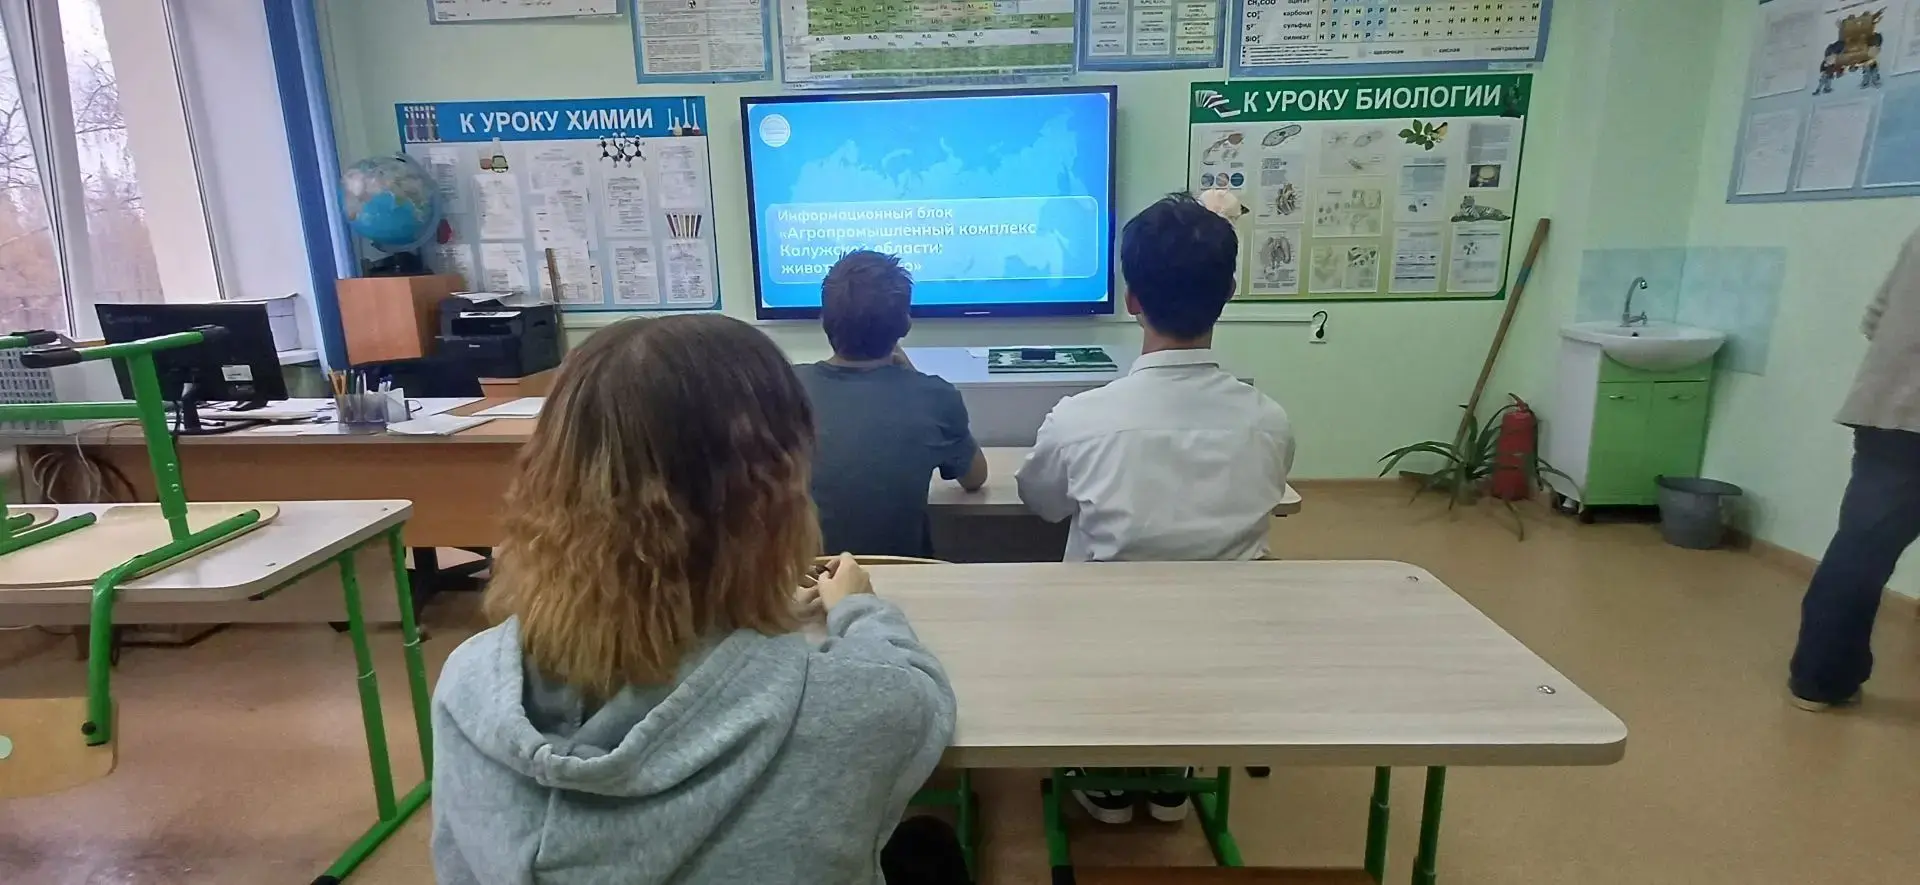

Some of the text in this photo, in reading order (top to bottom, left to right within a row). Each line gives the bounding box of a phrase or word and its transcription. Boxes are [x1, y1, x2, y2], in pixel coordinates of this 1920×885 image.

[1243, 84, 1502, 113] К УРОКУ БИОЛОГИИ
[460, 108, 654, 133] К УРОКУ ХИМИИ
[777, 206, 953, 224] Информационный блок
[780, 222, 1037, 241] «Агропромышленный комплекс
